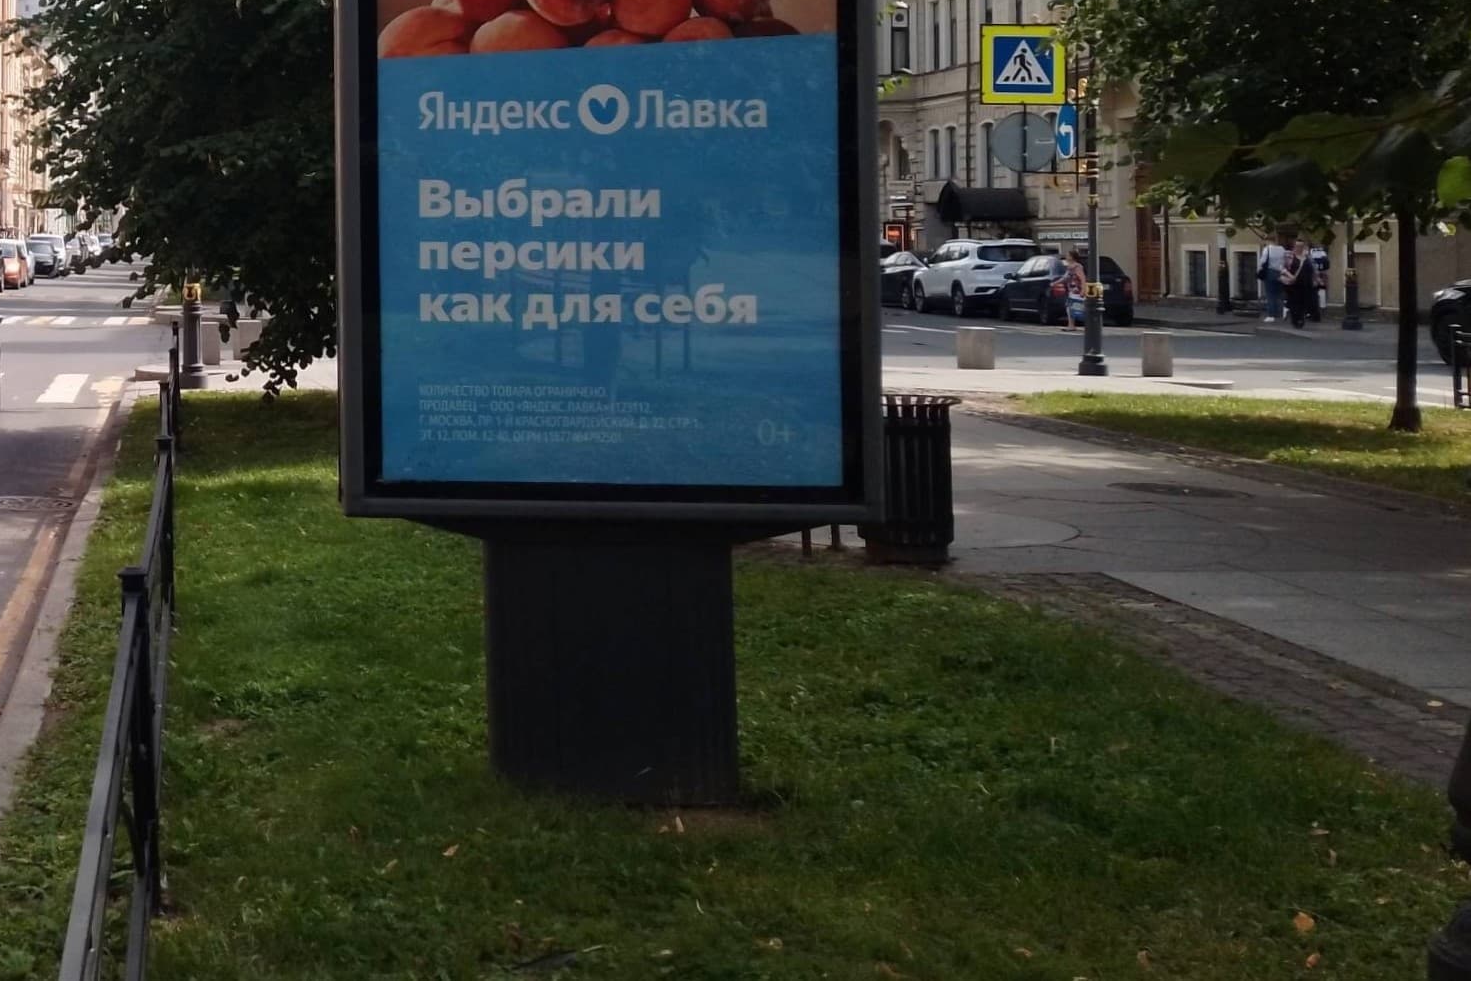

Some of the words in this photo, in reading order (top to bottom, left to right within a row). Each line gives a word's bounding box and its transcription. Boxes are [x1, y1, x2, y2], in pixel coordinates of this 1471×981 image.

[418, 91, 571, 136] Яндекс
[634, 89, 768, 130] Лавка
[418, 179, 661, 227] Выбрали
[418, 241, 645, 279] персики
[419, 292, 513, 323] как
[521, 293, 622, 330] для
[633, 282, 758, 325] себя
[758, 418, 798, 446] 0+
